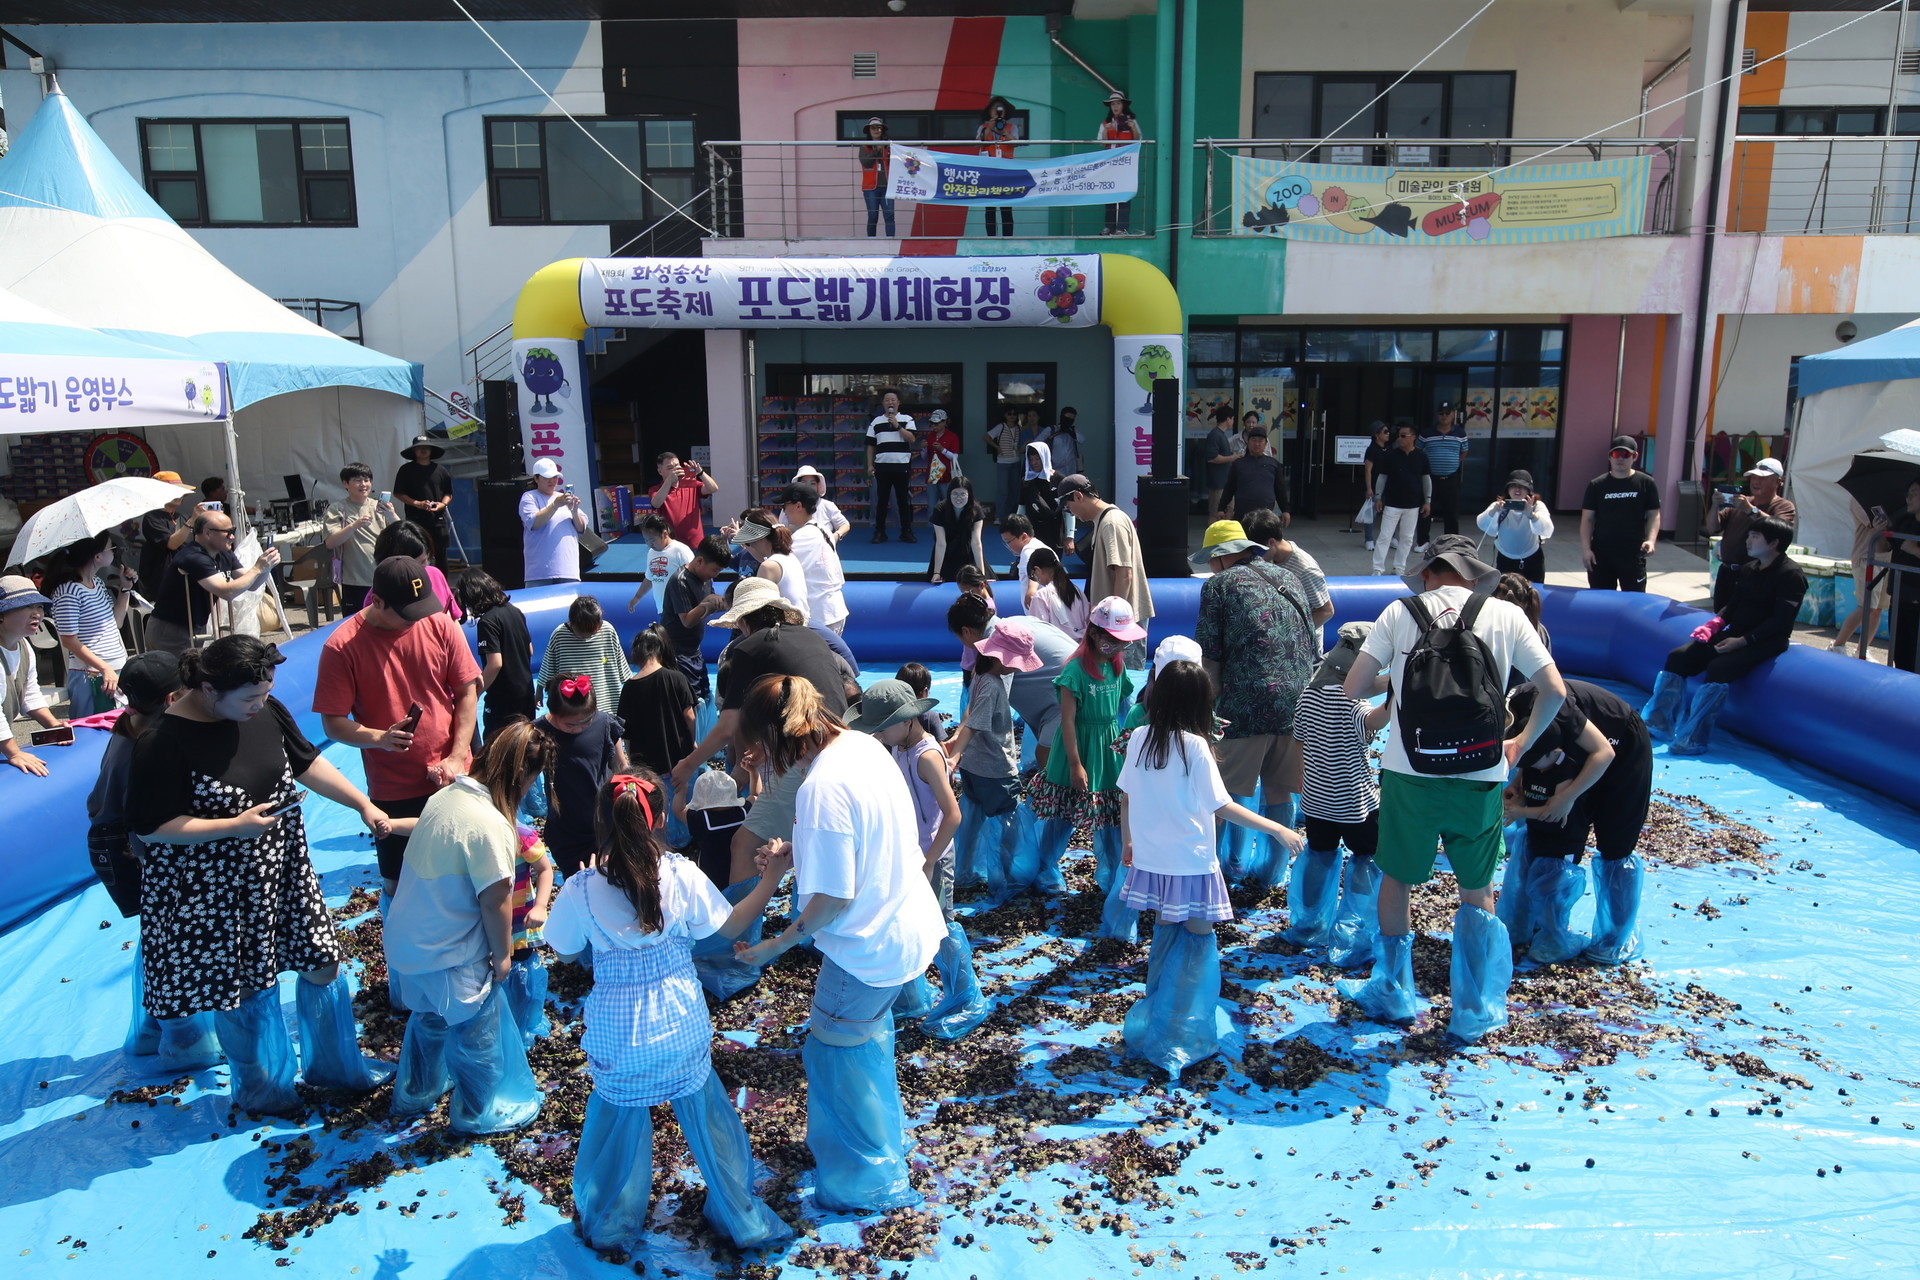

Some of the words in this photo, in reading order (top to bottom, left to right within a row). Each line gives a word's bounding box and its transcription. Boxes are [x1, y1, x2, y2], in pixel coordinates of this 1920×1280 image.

[943, 167, 981, 185] 행사장
[895, 185, 927, 197] 포도축제
[1273, 184, 1303, 202] ZOO
[1398, 180, 1444, 193] 미술관인
[1435, 201, 1490, 229] MUSEUM
[601, 269, 625, 278] 제9회
[630, 264, 712, 284] 화성송산
[895, 266, 920, 275] Grape
[604, 287, 714, 321] 포도축제
[737, 275, 1016, 322] 포도밟기체험장
[0, 376, 58, 413] 도밟기
[65, 376, 134, 413] 운영부스
[1604, 491, 1639, 499] DESCENTE
[411, 577, 424, 598] P
[1438, 738, 1475, 746] TOMMY
[1431, 752, 1482, 762] HILFIGER
